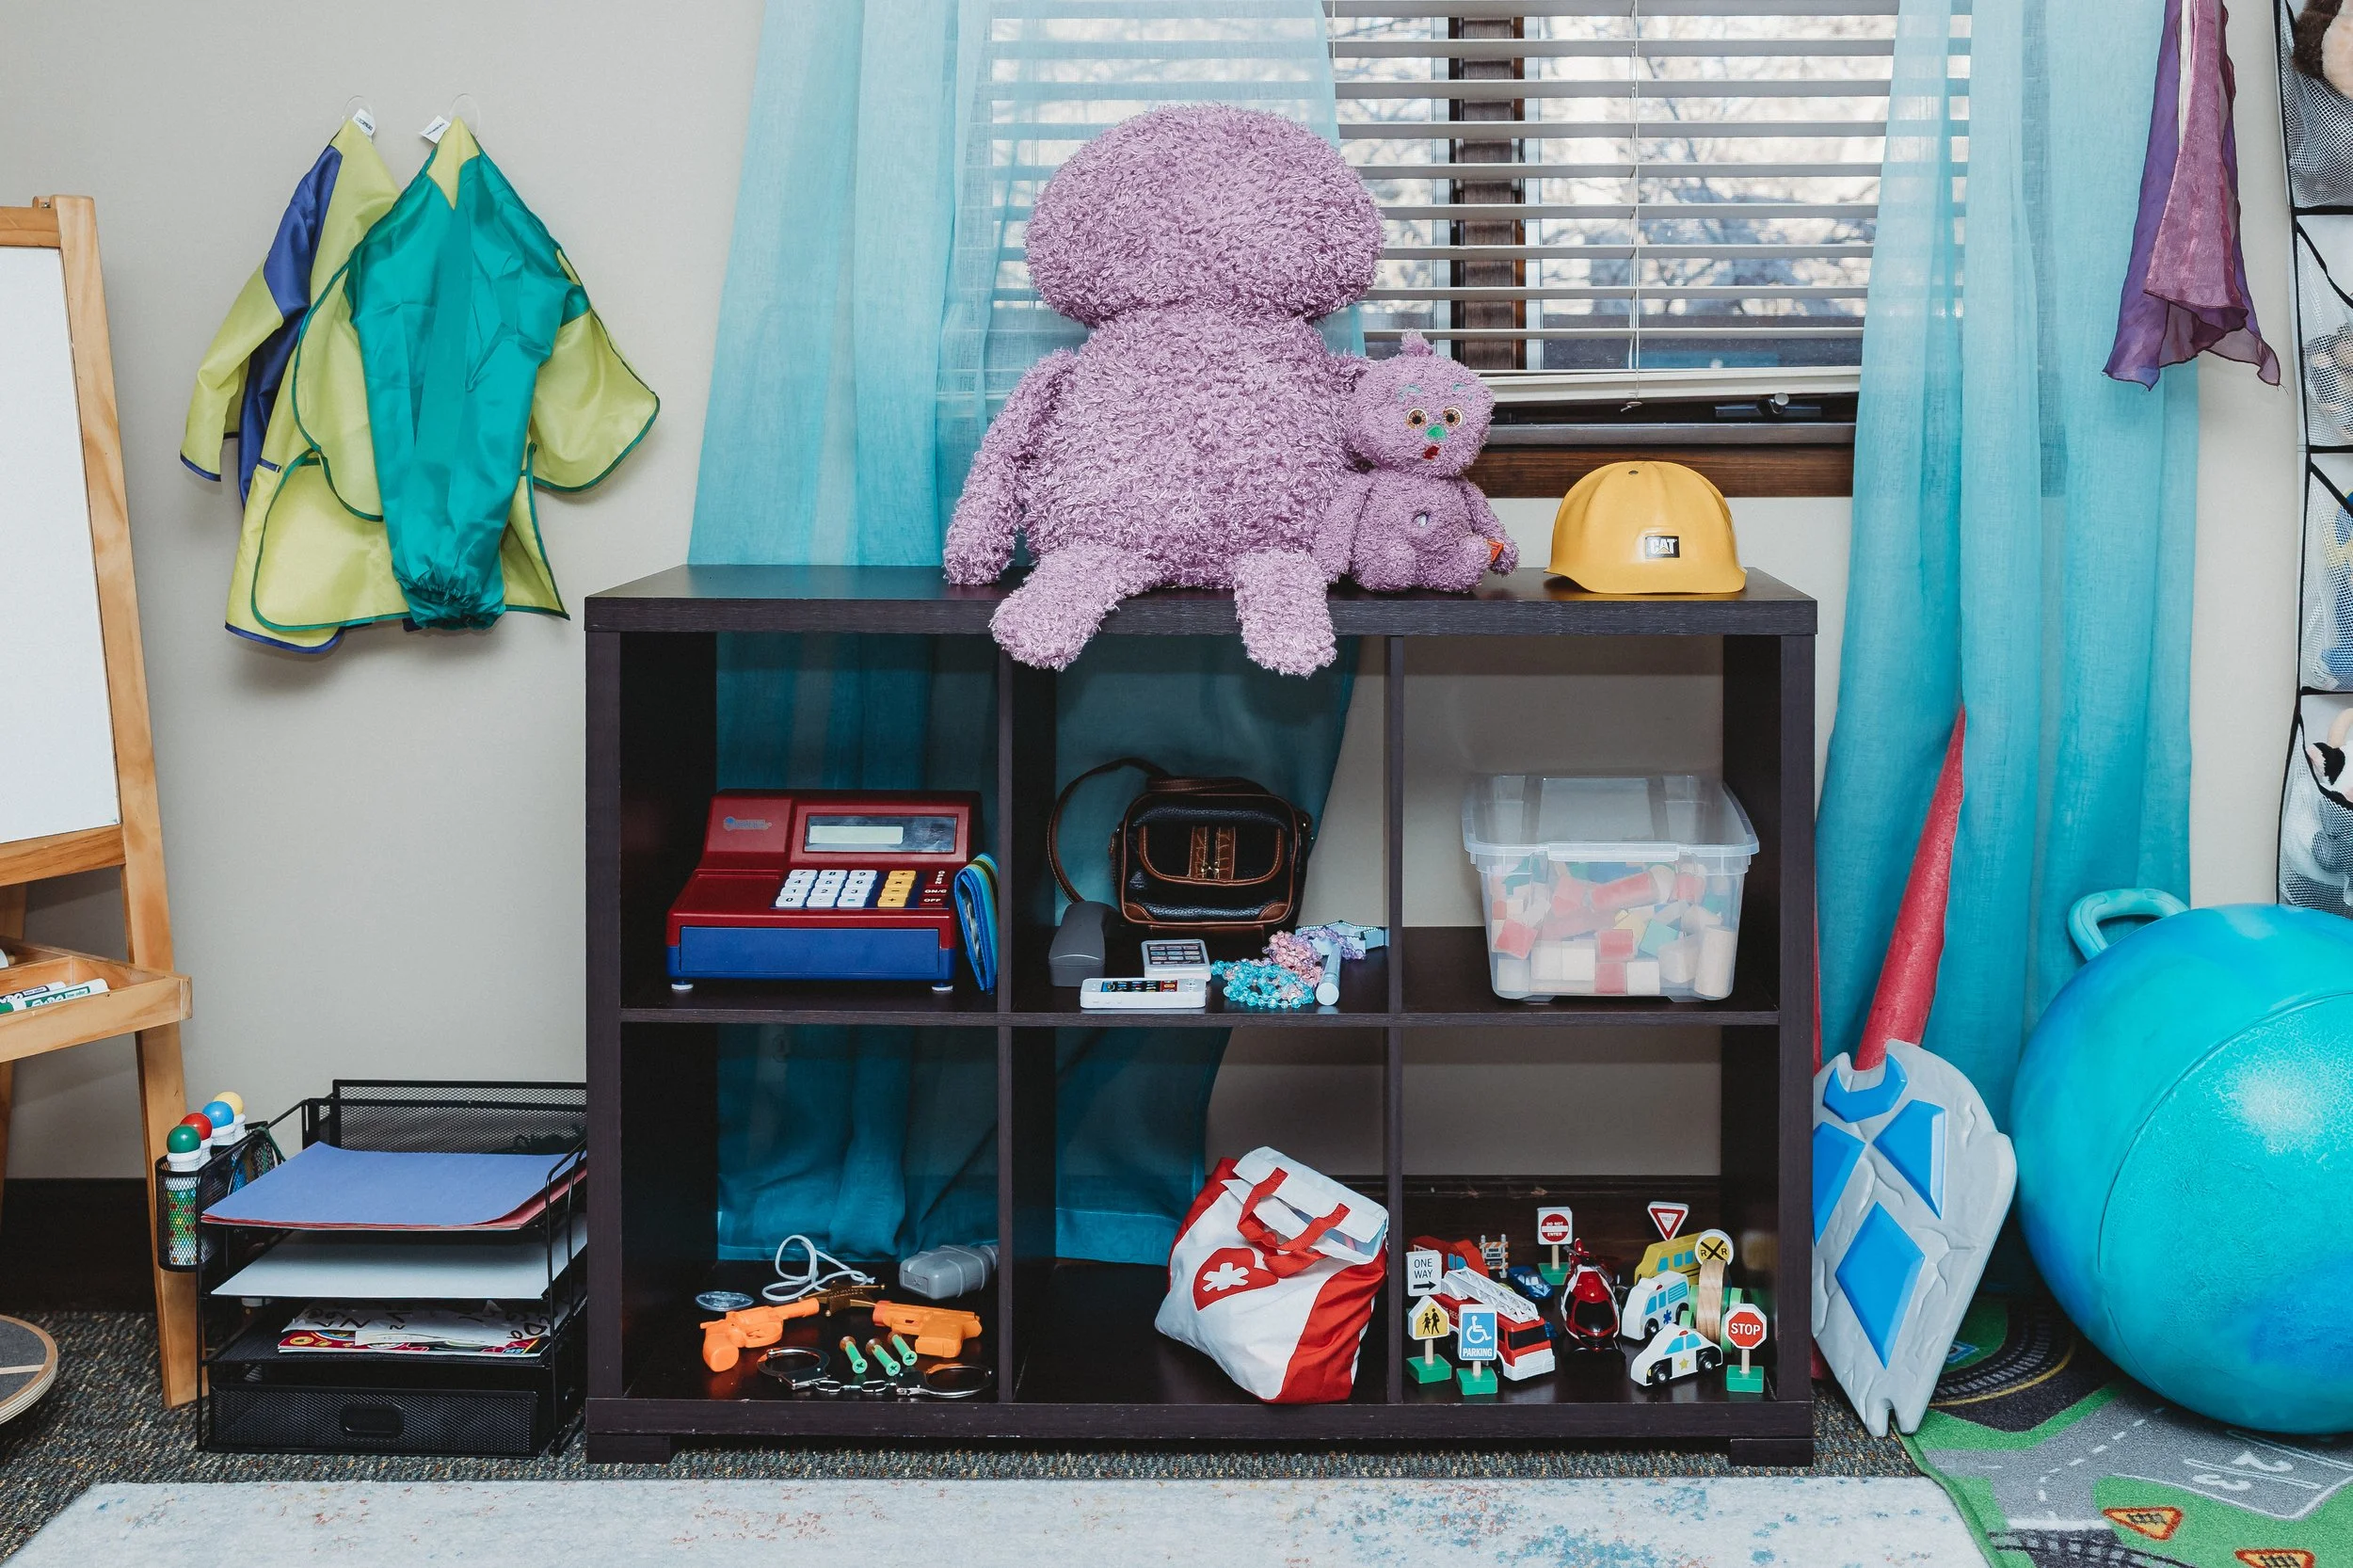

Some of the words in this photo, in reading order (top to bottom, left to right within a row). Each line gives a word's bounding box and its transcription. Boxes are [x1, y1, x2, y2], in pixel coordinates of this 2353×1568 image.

[1650, 538, 1674, 554] CAT
[1414, 1257, 1433, 1268] ONE
[1414, 1270, 1433, 1279] WAY
[1731, 1322, 1761, 1336] STOP
[1463, 1348, 1493, 1357] PARKING
